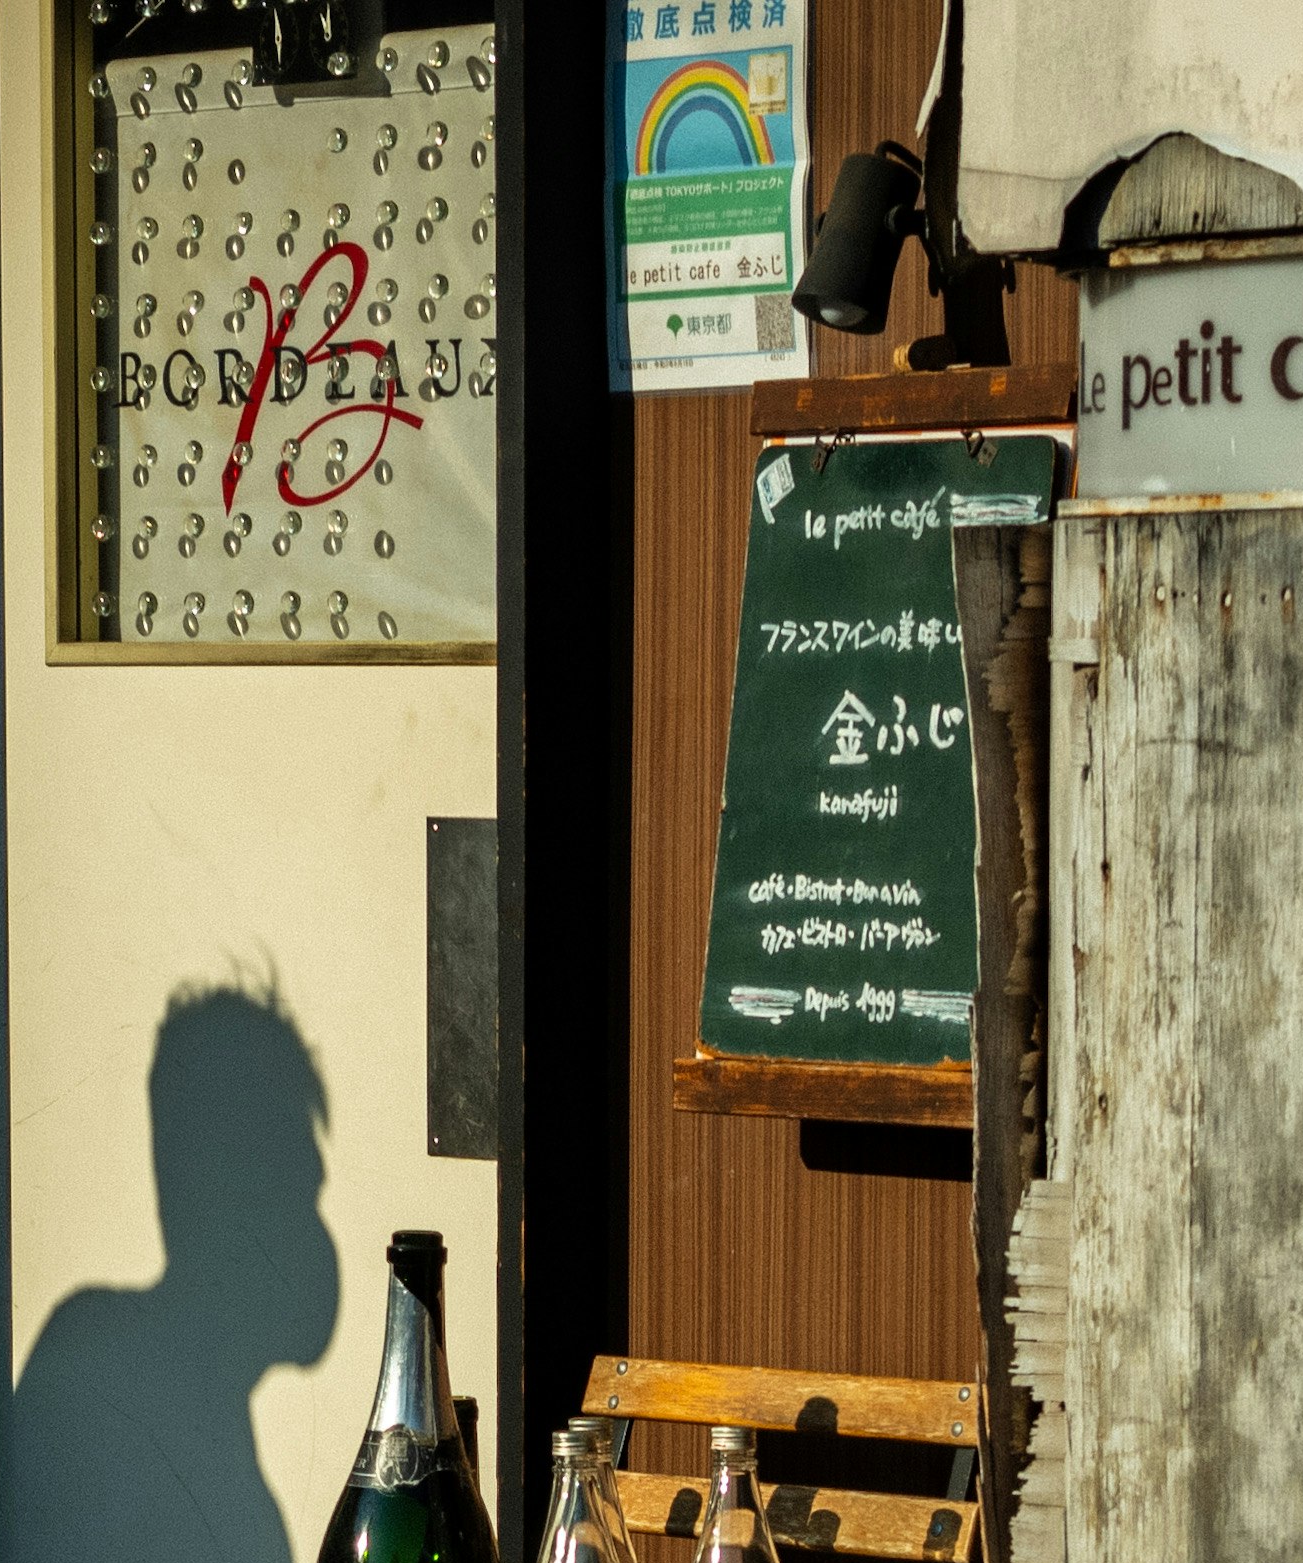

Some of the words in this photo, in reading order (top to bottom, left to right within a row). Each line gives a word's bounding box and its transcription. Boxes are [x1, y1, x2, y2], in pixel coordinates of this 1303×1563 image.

[644, 263, 682, 286] petit
[689, 260, 721, 280] cafe
[737, 255, 783, 278] 金ふじ
[687, 313, 732, 336] 東京都
[1079, 341, 1106, 416] Le
[1122, 320, 1243, 431] petit
[805, 509, 827, 539] le
[834, 504, 886, 551] petit
[891, 485, 946, 541] café
[821, 689, 965, 765] 金ふじ
[820, 784, 898, 825] kanafuji
[805, 986, 850, 1022] Depuis
[855, 982, 896, 1023] 1999
